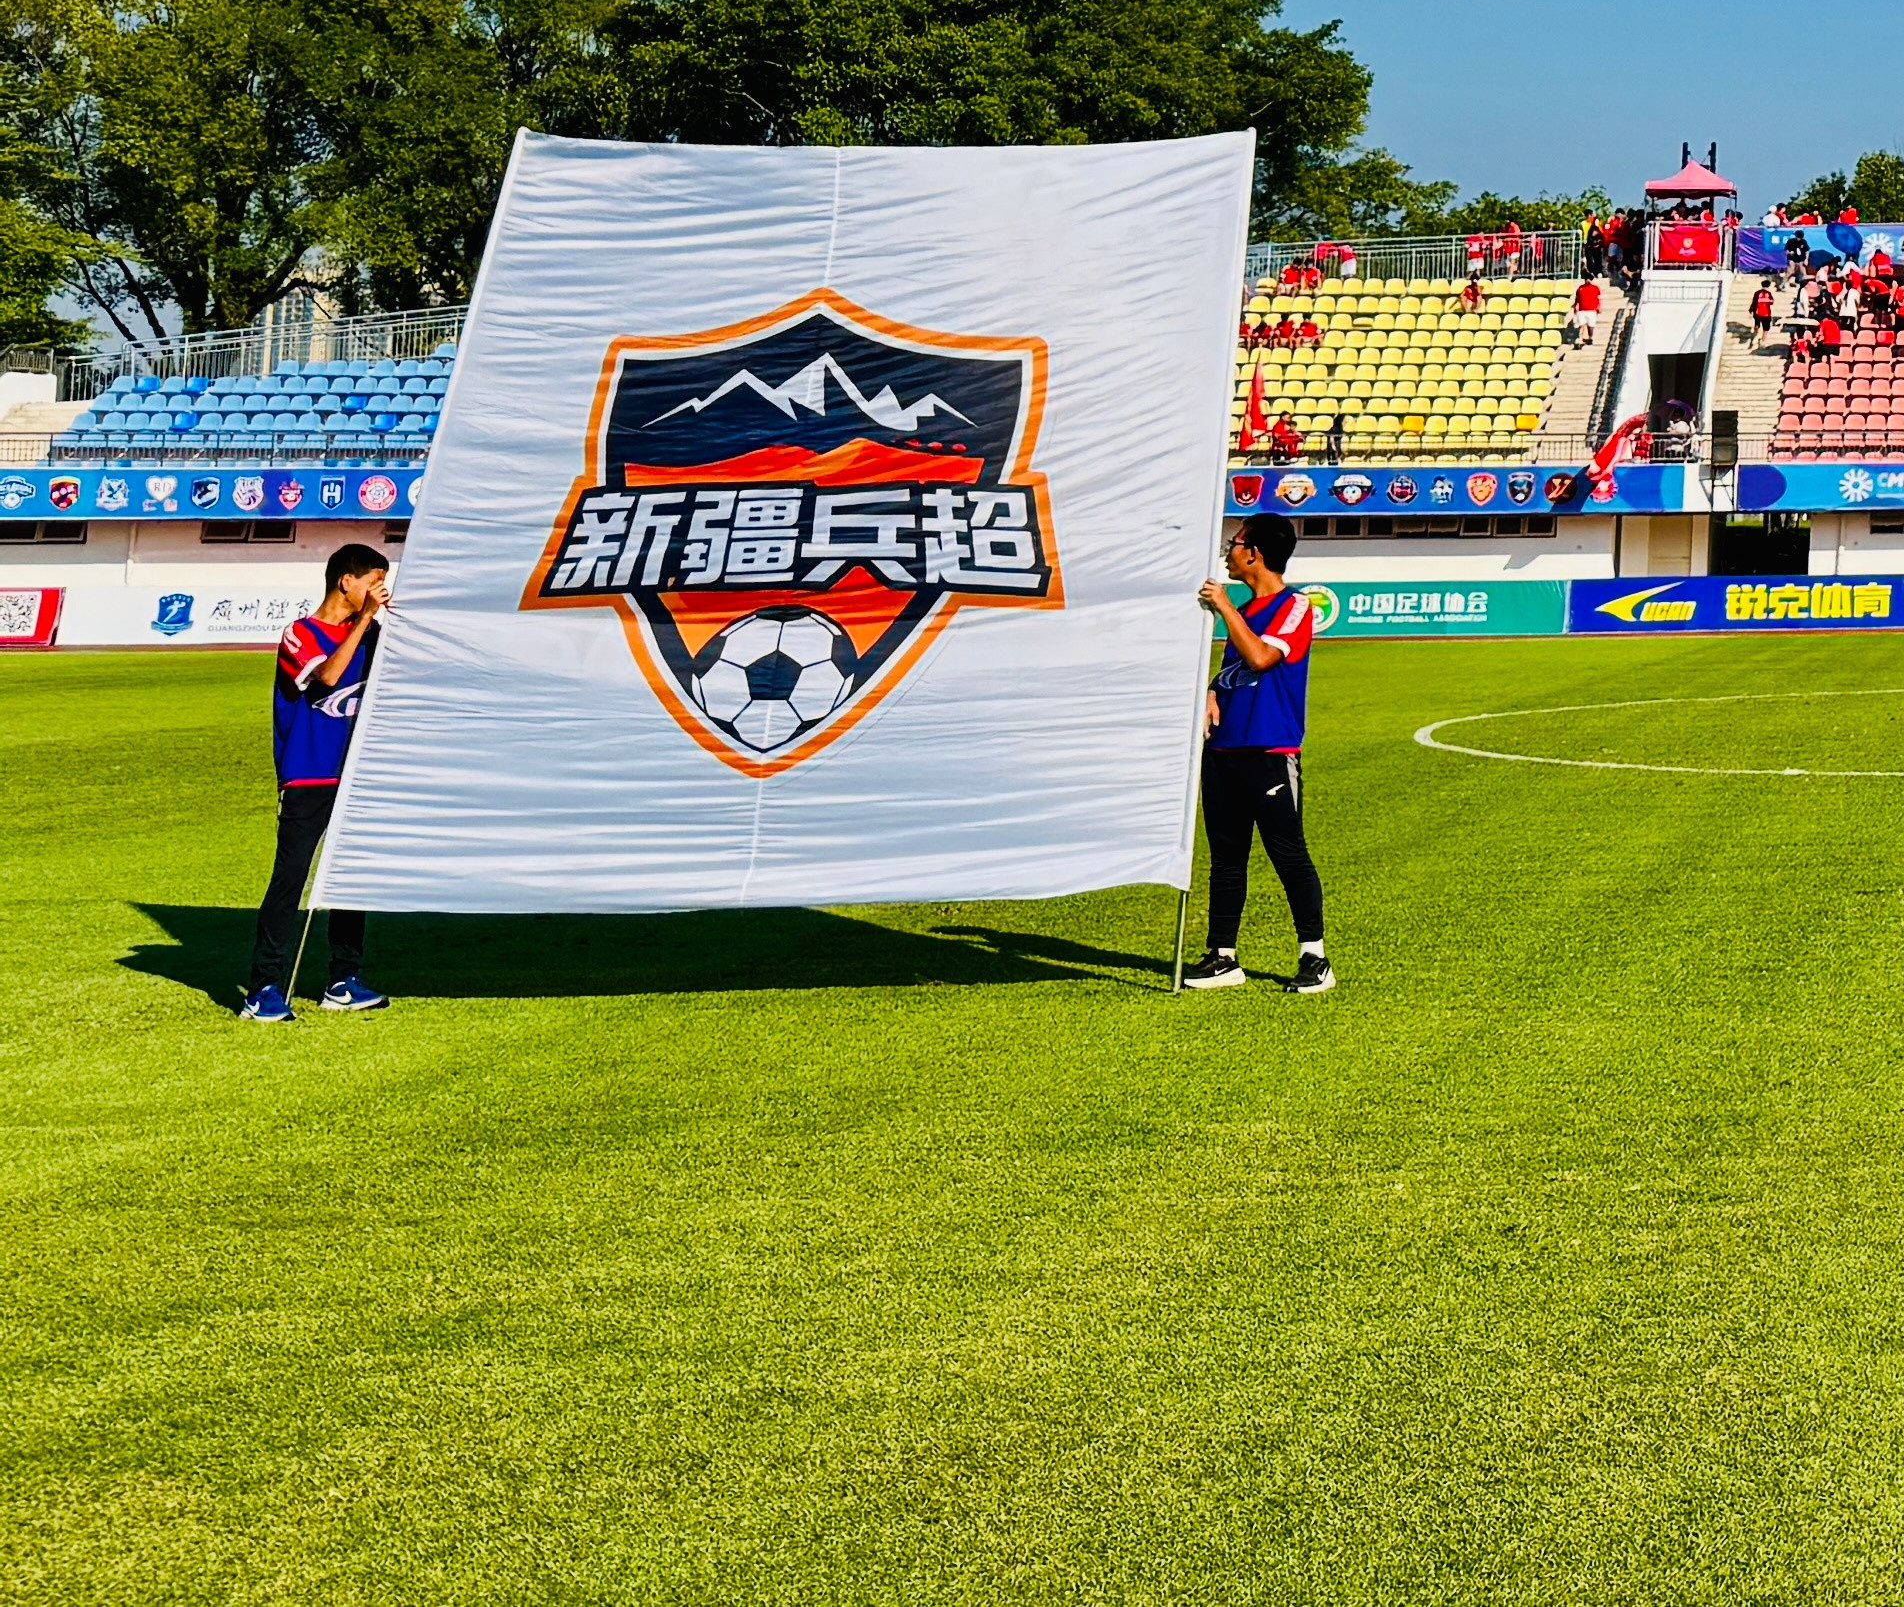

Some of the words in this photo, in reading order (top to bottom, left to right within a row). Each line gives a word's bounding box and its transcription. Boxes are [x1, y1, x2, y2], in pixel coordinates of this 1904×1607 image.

[549, 487, 1043, 590] 新疆兵超
[1348, 591, 1489, 615] 中国足球协会
[1725, 581, 1893, 621] 锐克体育
